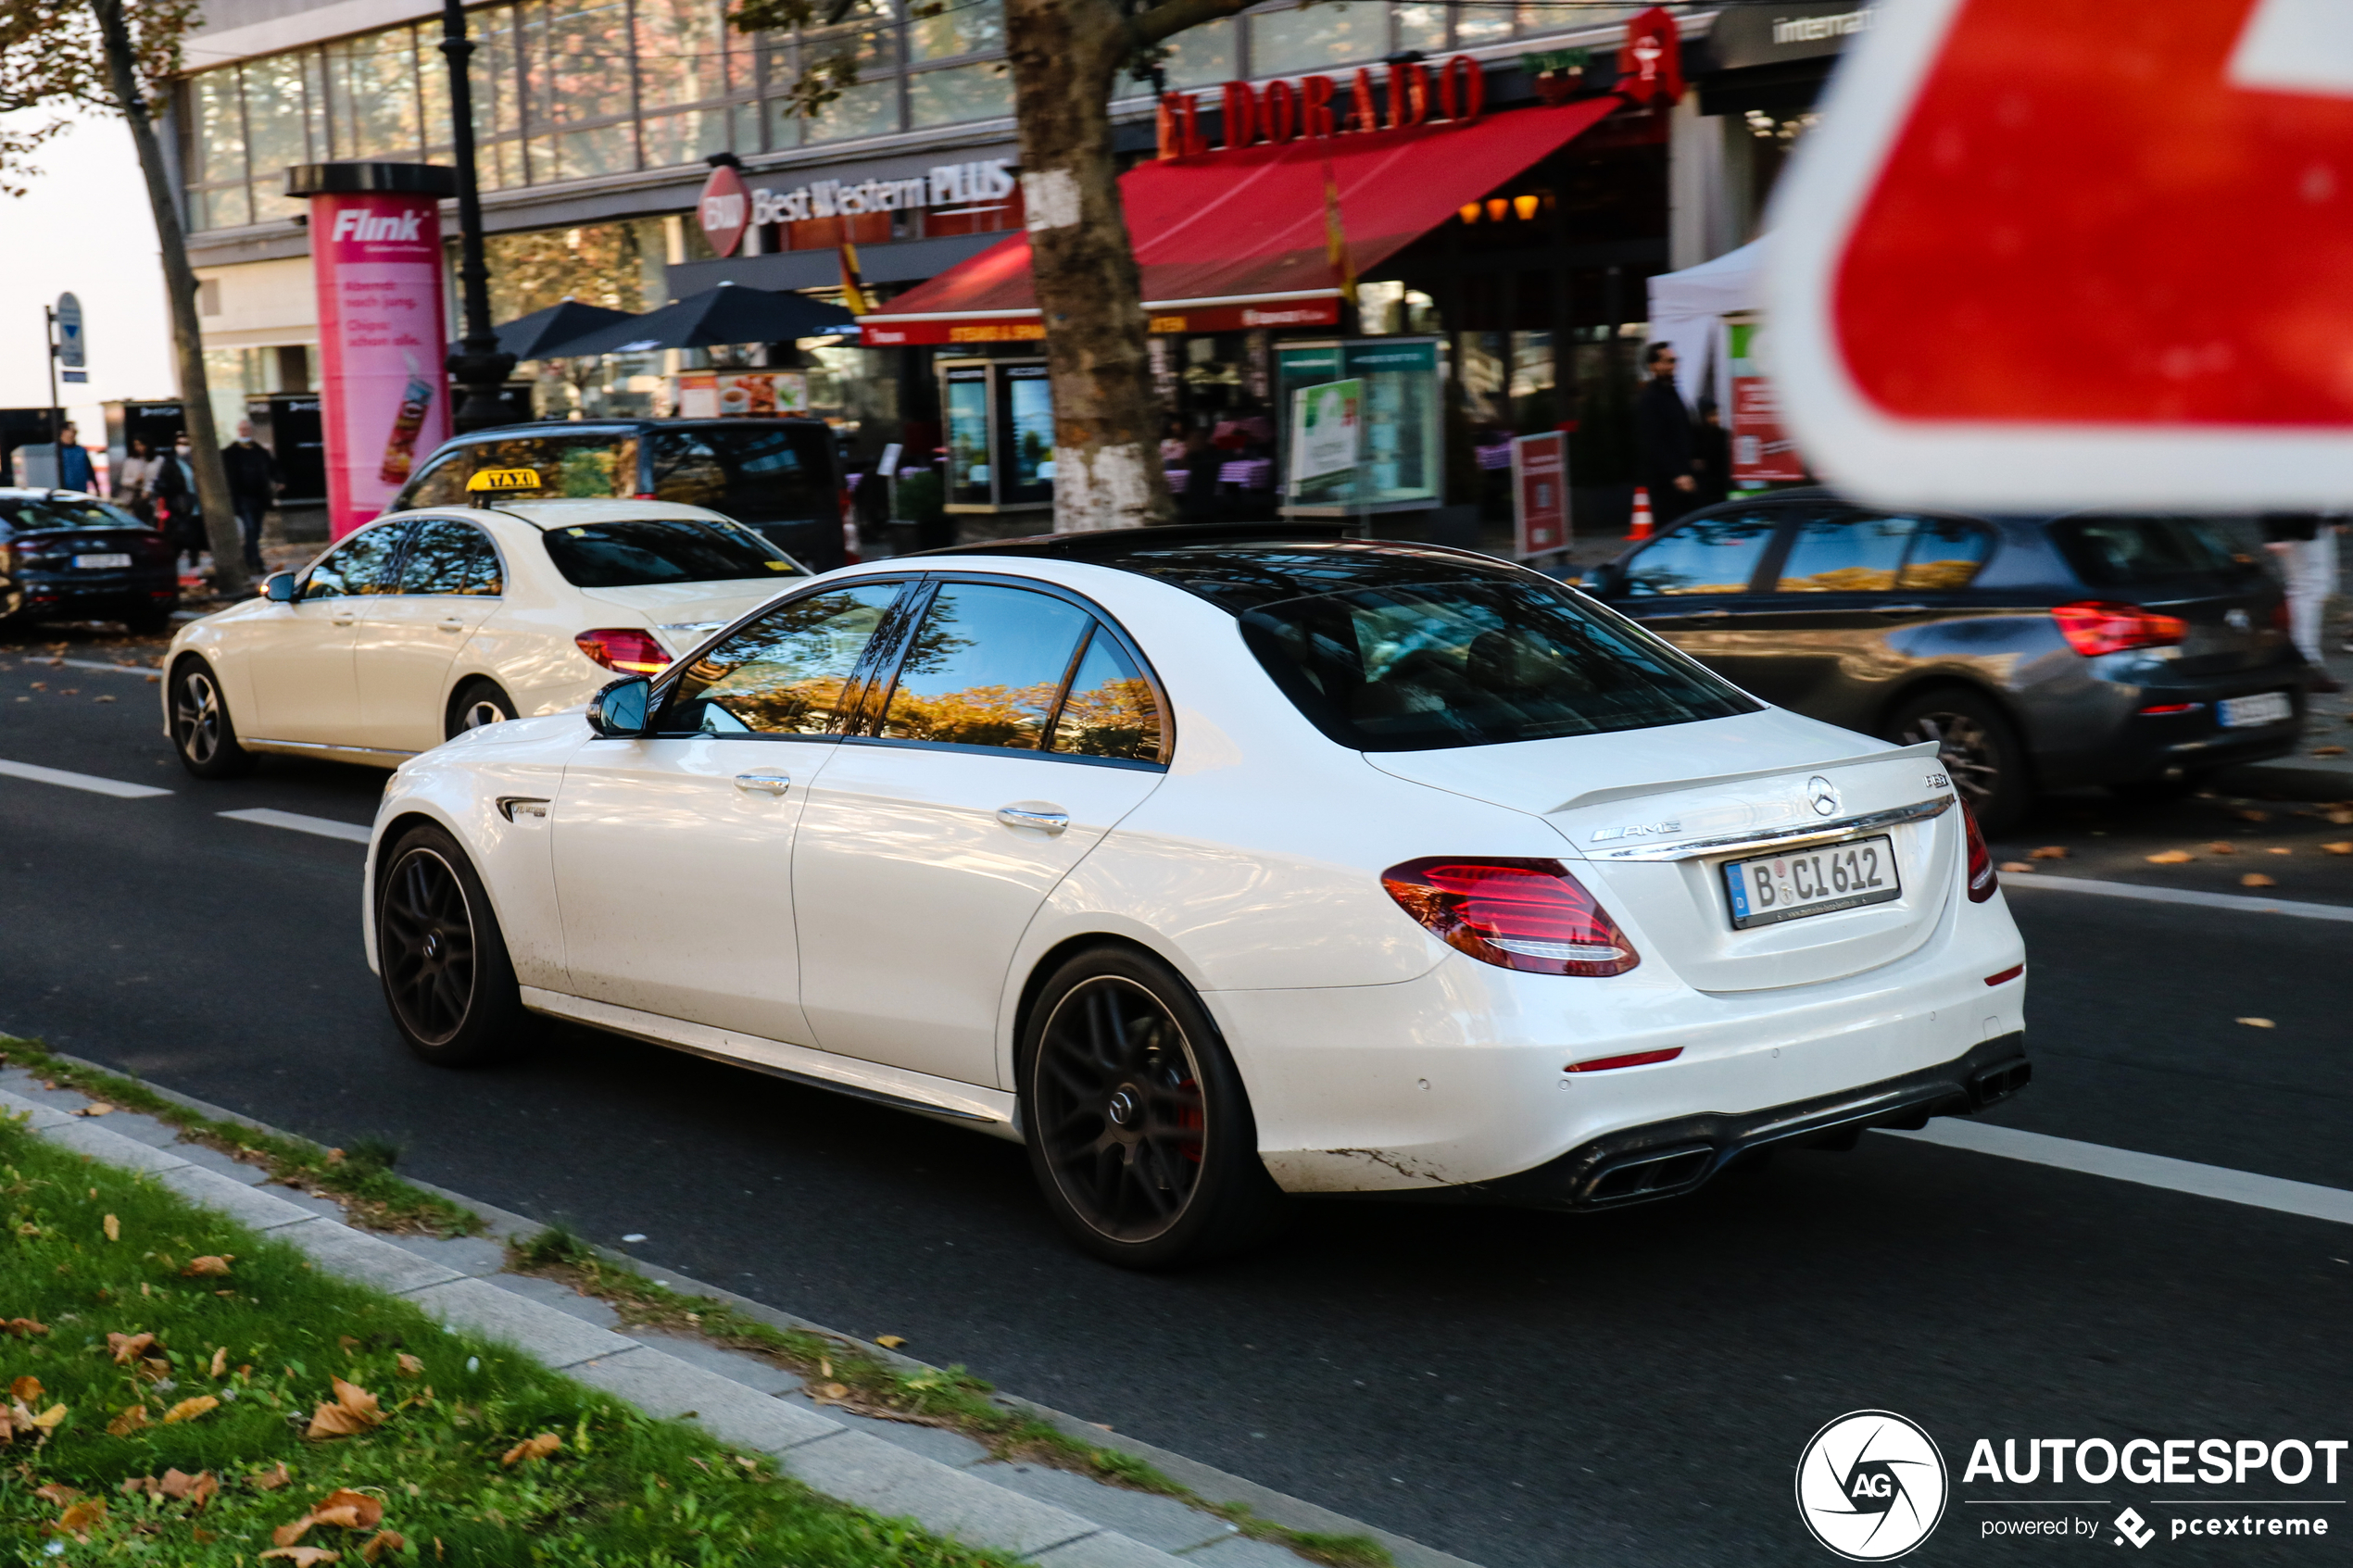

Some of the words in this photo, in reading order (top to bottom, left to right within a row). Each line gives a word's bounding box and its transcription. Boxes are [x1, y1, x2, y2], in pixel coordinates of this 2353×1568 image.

[1156, 91, 1210, 160] EL
[1221, 55, 1487, 148] DORADO
[751, 187, 812, 226] Best
[810, 178, 926, 218] Western
[928, 158, 1017, 206] PLUS
[332, 208, 422, 242] Flink
[488, 472, 534, 487] TAXI
[1621, 820, 1681, 838] AMG
[1753, 865, 1776, 907] B
[1832, 847, 1882, 893] 612
[1736, 897, 1745, 909] D
